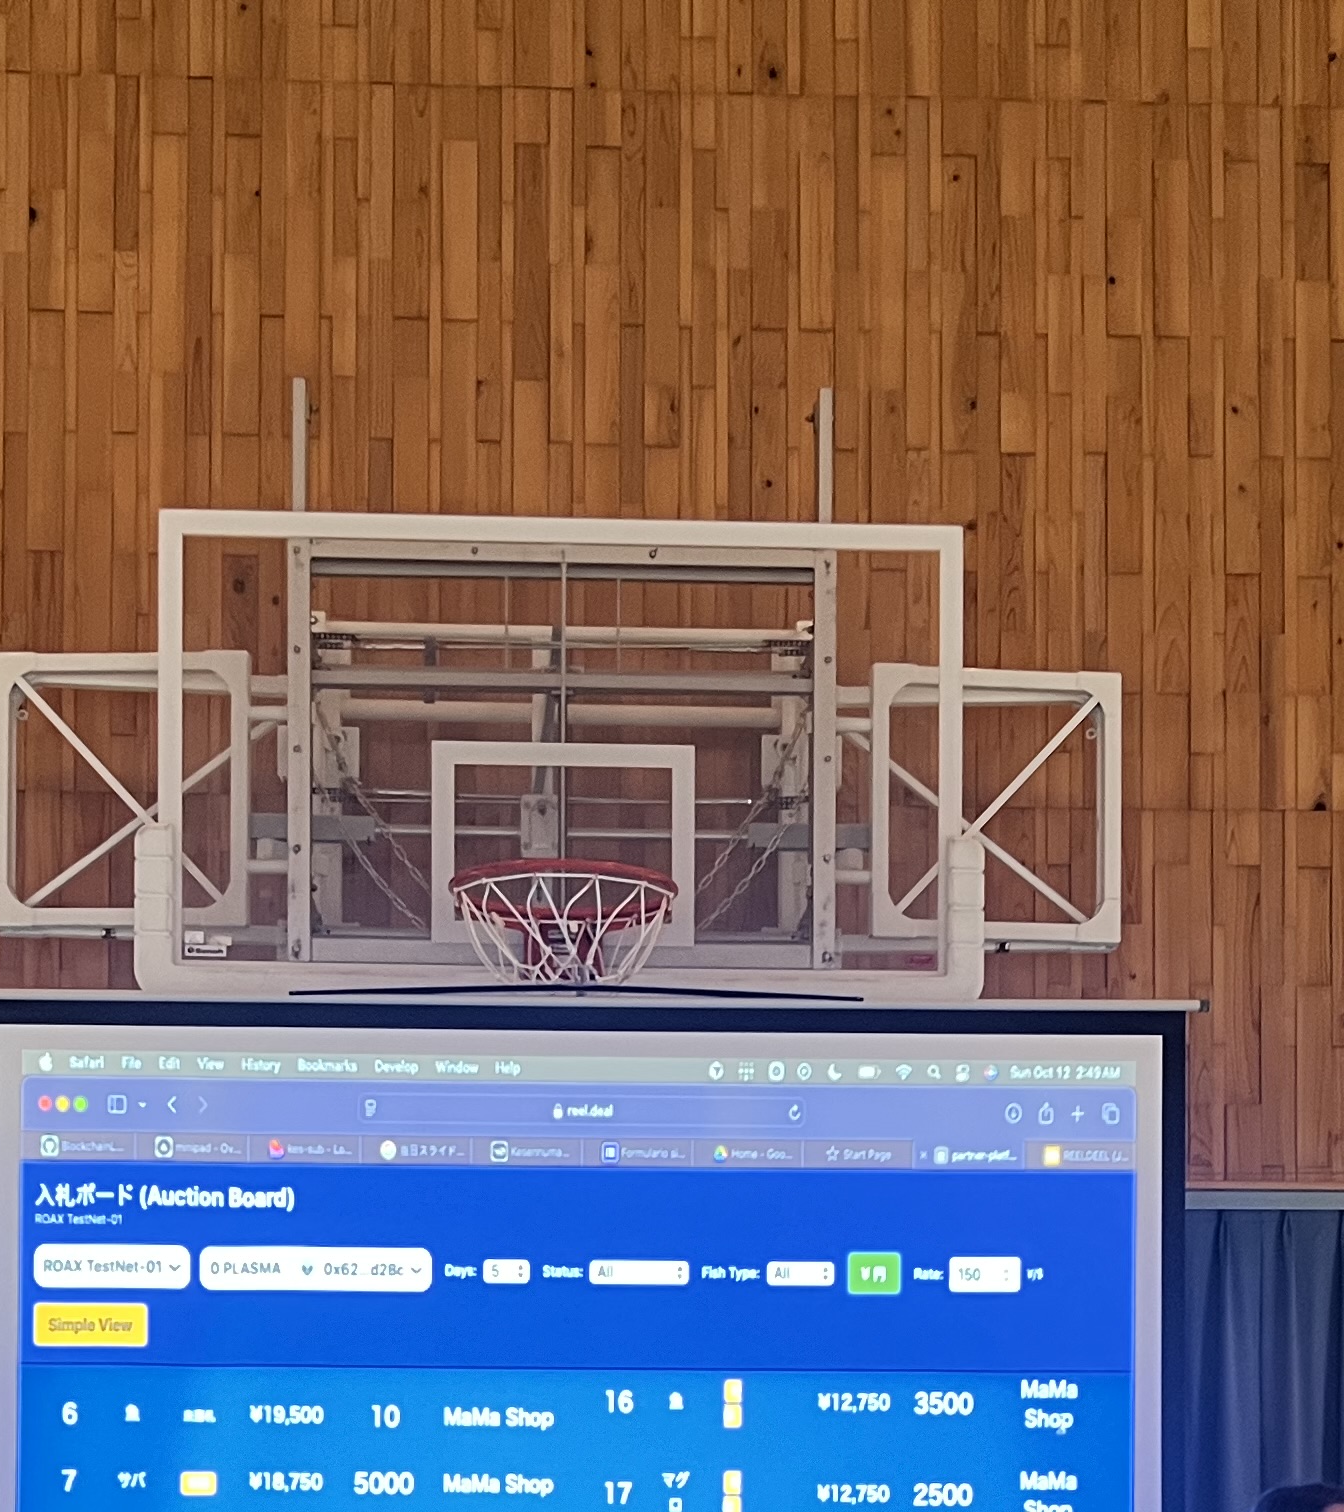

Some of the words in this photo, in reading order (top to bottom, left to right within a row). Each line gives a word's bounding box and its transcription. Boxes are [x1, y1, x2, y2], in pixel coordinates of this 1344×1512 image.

[69, 1055, 105, 1070] Safari
[121, 1056, 143, 1070] File
[158, 1056, 181, 1070] Edit
[196, 1056, 226, 1071] View
[240, 1057, 281, 1074] History
[297, 1058, 358, 1073] Bookmarks
[374, 1058, 419, 1076] Develop
[434, 1059, 480, 1074] Window
[494, 1060, 521, 1077] Help
[1009, 1064, 1032, 1079] Sun
[1033, 1064, 1054, 1079] Oct
[1055, 1064, 1071, 1080] 12
[566, 1103, 614, 1118] reel.deal
[34, 1182, 134, 1208] 入札ボード
[139, 1184, 225, 1211] (Auction
[228, 1186, 295, 1213] Board)
[34, 1213, 65, 1225] ROAX
[43, 1259, 83, 1273] ROAX
[86, 1259, 162, 1274] TestNet-01
[223, 1261, 281, 1275] PLASMA
[444, 1263, 478, 1280] Days:
[491, 1264, 500, 1278] 5
[542, 1264, 584, 1279] Status:
[597, 1265, 613, 1278] All
[701, 1265, 727, 1280] Fish
[728, 1266, 761, 1282] Type:
[774, 1266, 790, 1279] All
[958, 1267, 981, 1282] 150
[47, 1317, 96, 1335] Simple
[98, 1317, 133, 1332] View
[1020, 1379, 1079, 1399] MaMa
[605, 1389, 635, 1415] 16
[817, 1392, 891, 1414] ¥12,750
[913, 1390, 975, 1416] 3500
[61, 1401, 79, 1426] 6
[249, 1404, 325, 1426] ¥19,500
[371, 1404, 401, 1429] 10
[443, 1406, 501, 1427] MaMa
[505, 1406, 555, 1431] Shop
[1024, 1407, 1074, 1435] Shop
[61, 1468, 78, 1493] 7
[117, 1471, 147, 1489] サバ
[248, 1471, 324, 1493] ¥18,750
[353, 1470, 415, 1496] 5000
[442, 1472, 501, 1494] MaMa
[504, 1472, 555, 1498] Shop
[1019, 1470, 1078, 1491] MaMa
[604, 1480, 633, 1505] 17
[816, 1483, 891, 1505] ¥12,750
[912, 1482, 974, 1507] 2500
